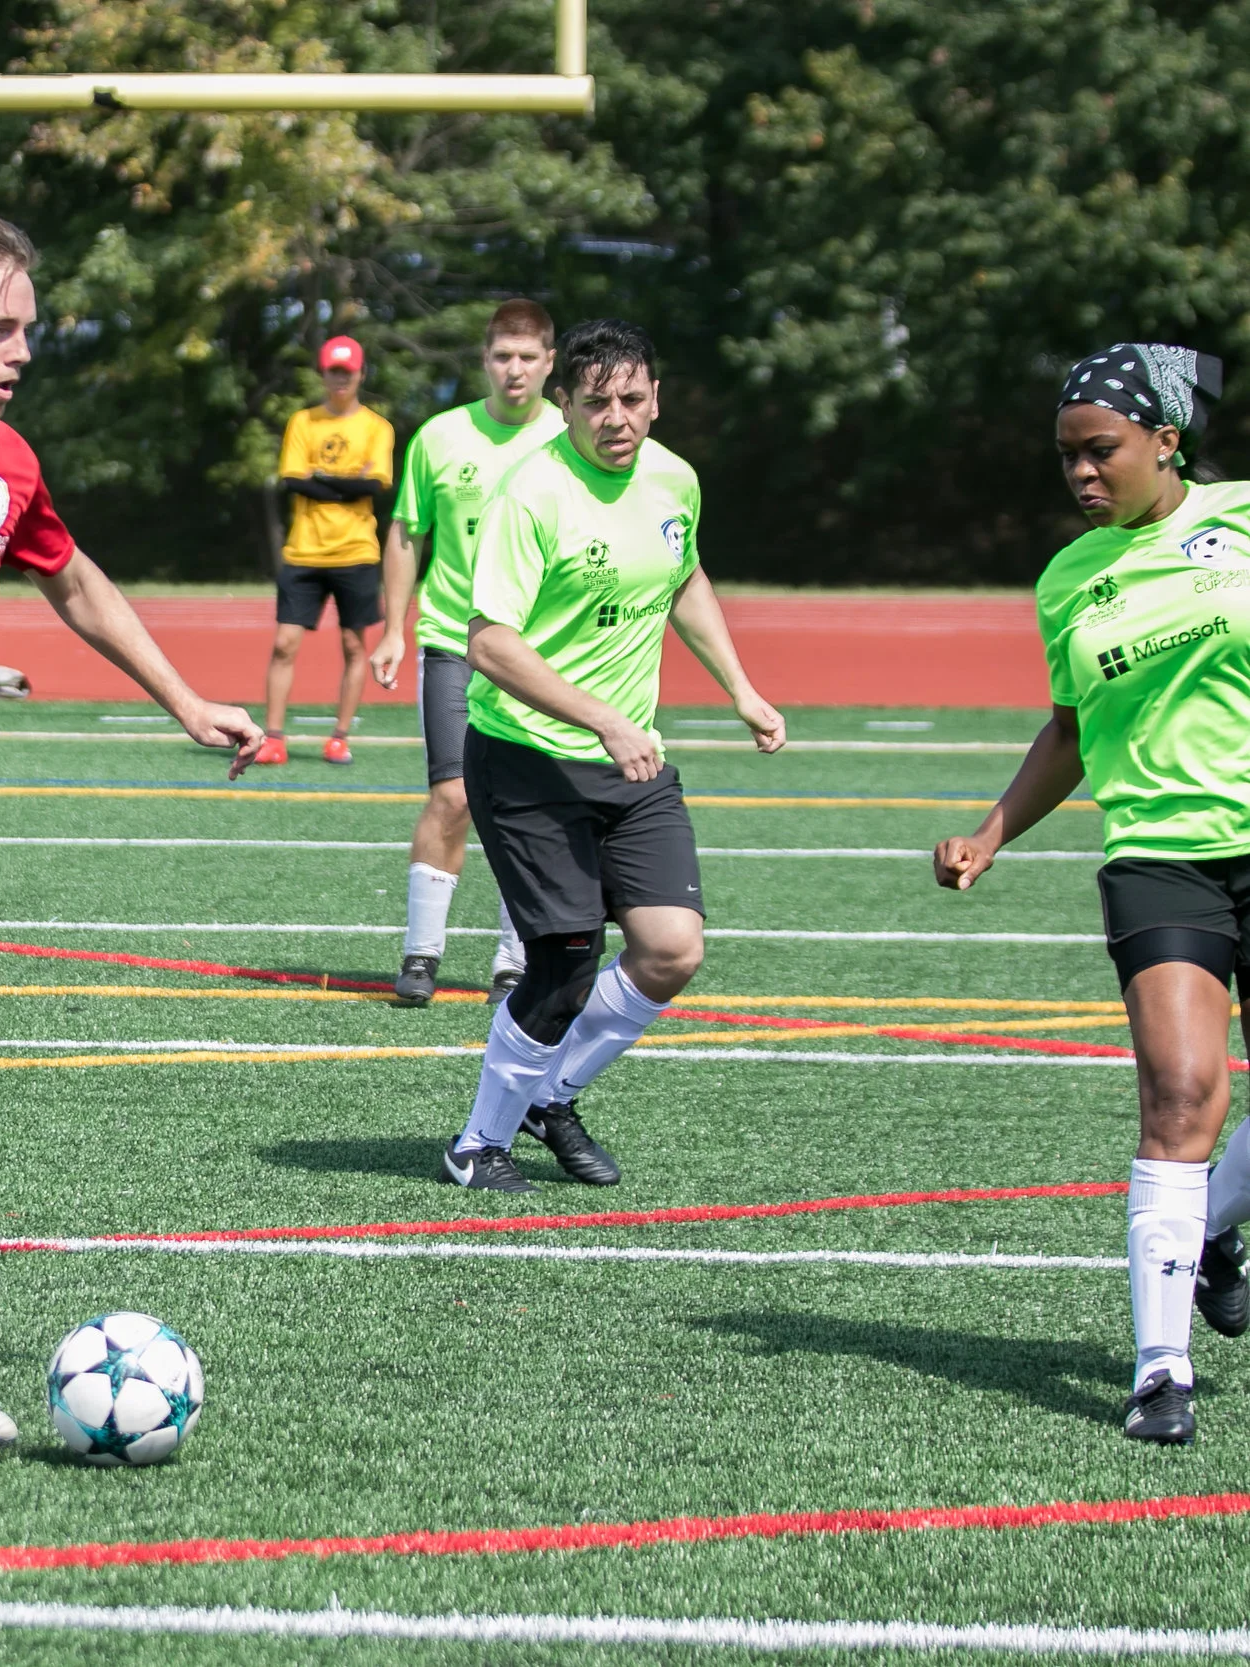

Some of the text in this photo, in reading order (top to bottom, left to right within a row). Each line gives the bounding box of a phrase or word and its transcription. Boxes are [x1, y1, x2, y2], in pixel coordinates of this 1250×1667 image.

[582, 567, 619, 580] SOCCER
[590, 577, 620, 587] STREETS
[623, 595, 672, 621] Microsof
[1132, 616, 1230, 662] Microsoft
